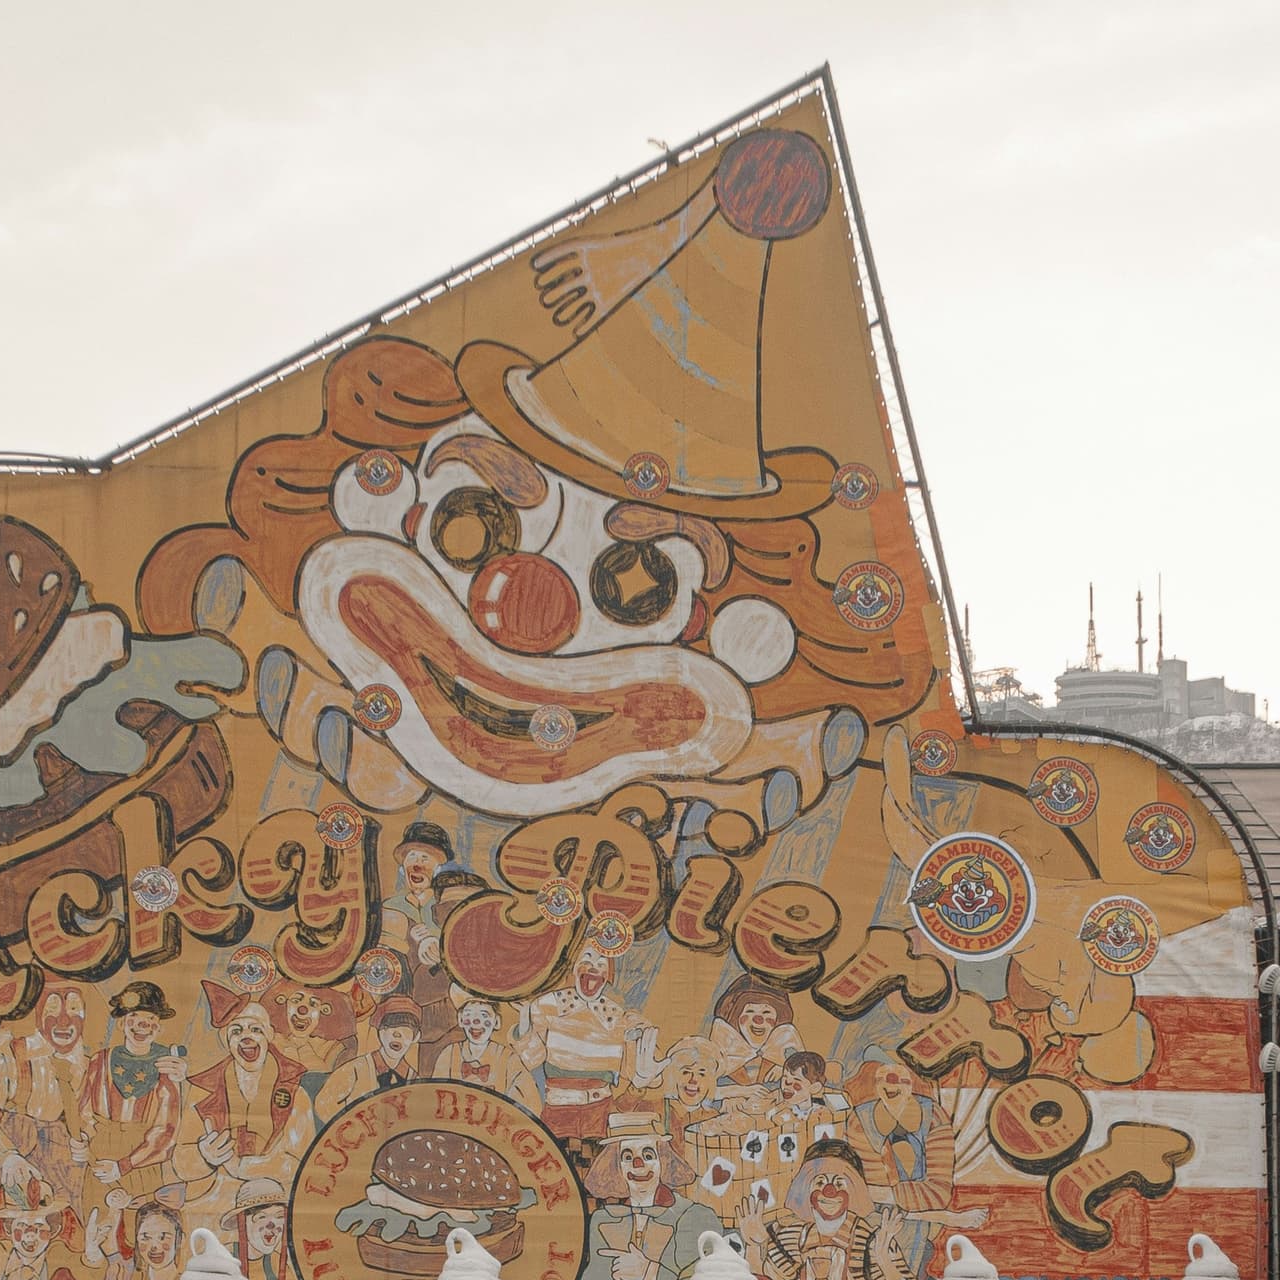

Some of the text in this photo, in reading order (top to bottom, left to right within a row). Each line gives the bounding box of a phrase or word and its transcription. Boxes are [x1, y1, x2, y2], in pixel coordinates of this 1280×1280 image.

[842, 565, 898, 588] HAMBURGER
[841, 593, 902, 628] LUCKY PIERROT
[1036, 761, 1091, 784] HAMBURGER
[1035, 788, 1094, 822] LUCKY PIERROT
[1134, 807, 1189, 830] HAMBURGER
[928, 845, 1021, 884] HAMBURGER
[1133, 834, 1192, 868] LUCKY PIERROT
[926, 892, 1027, 949] LUCKY PIERROT
[1092, 902, 1153, 928] HAMBURGER
[1090, 933, 1157, 970] LUCKY PIERROT
[305, 1089, 571, 1212] LUCKY BURGER
